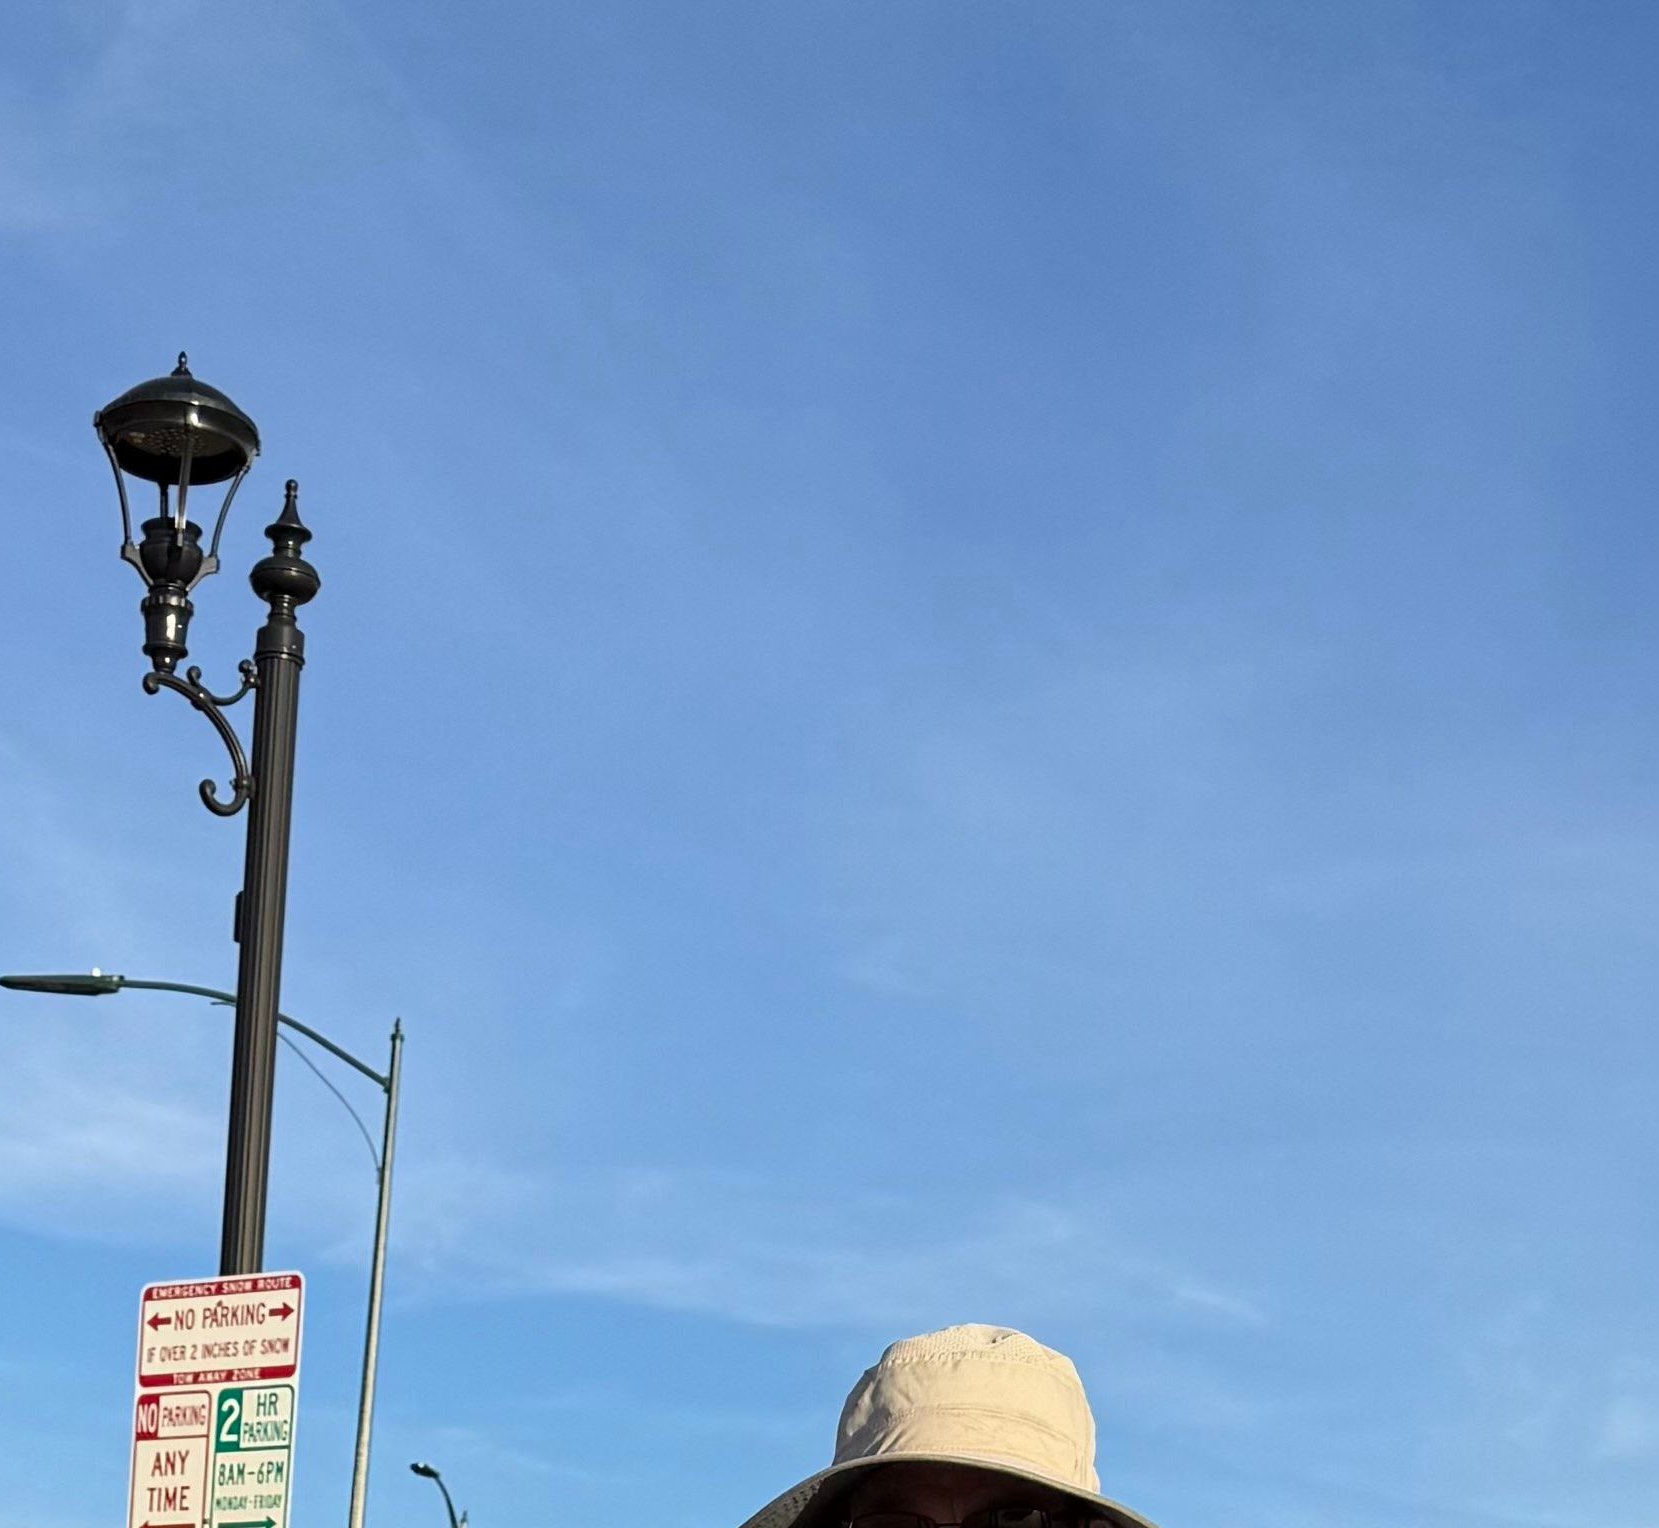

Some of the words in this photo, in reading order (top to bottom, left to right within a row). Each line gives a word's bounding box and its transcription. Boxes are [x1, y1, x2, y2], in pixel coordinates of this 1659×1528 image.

[152, 1284, 217, 1298] EMERGENCY
[222, 1280, 253, 1293] SNOW
[257, 1277, 292, 1289] ROUTE
[174, 1309, 195, 1331] NO
[202, 1302, 266, 1329] PARKING
[147, 1347, 156, 1363] IF
[160, 1345, 186, 1362] OVER
[190, 1344, 198, 1360] 2
[202, 1341, 239, 1359] INCHES
[243, 1340, 257, 1356] OF
[261, 1338, 290, 1355] SNOW
[173, 1373, 194, 1385] TOW
[198, 1371, 228, 1382] AWAY
[232, 1368, 261, 1380] ZONE
[137, 1403, 158, 1433] NO
[162, 1405, 206, 1428] PARKING
[219, 1398, 240, 1442] 2
[256, 1393, 278, 1416] HR
[242, 1420, 288, 1443] PARKING
[151, 1450, 189, 1477] ANY
[147, 1486, 191, 1512] TIME
